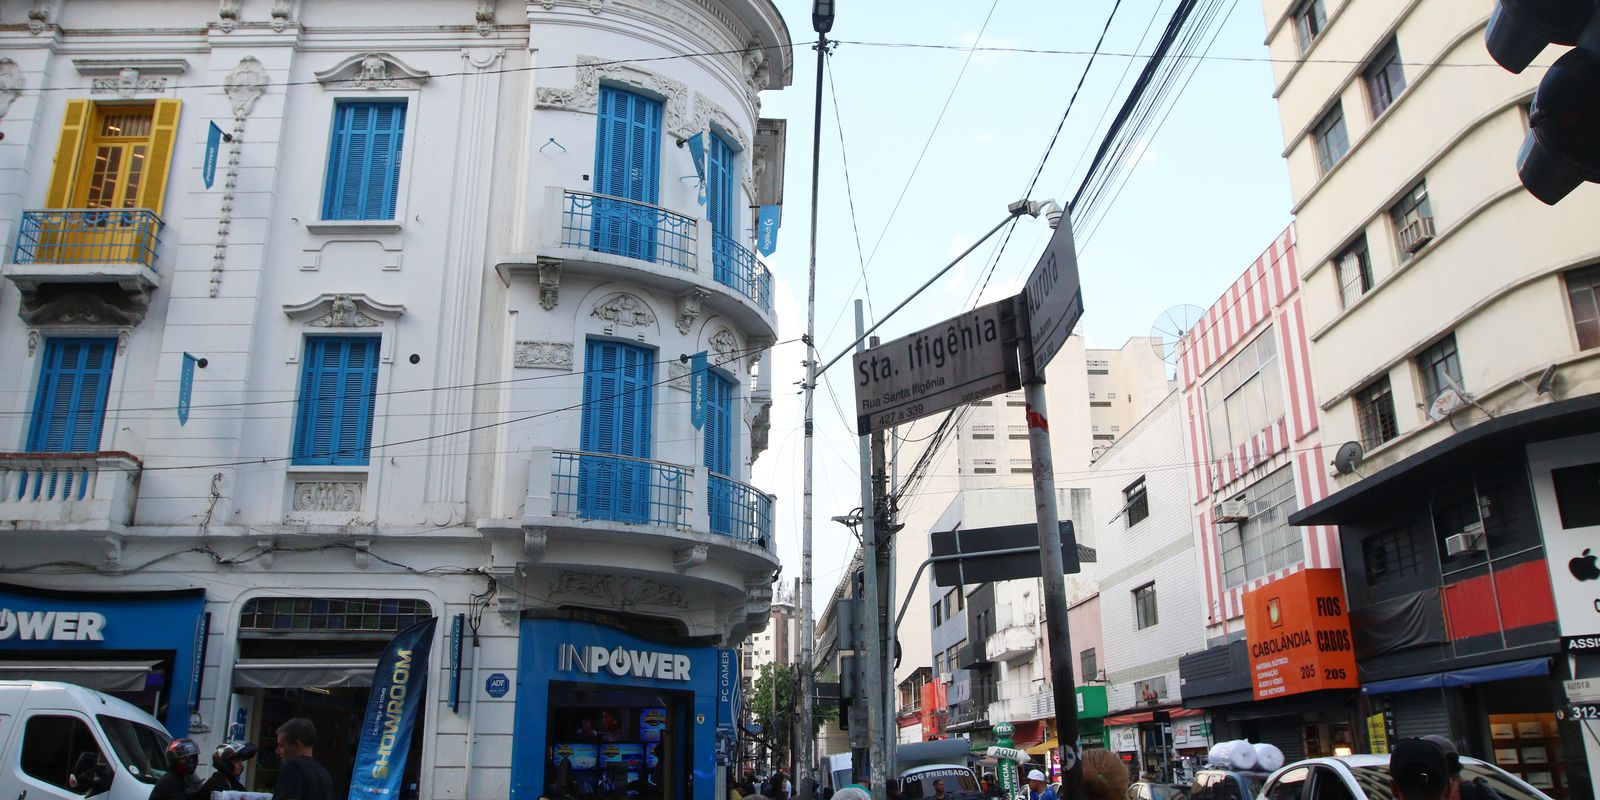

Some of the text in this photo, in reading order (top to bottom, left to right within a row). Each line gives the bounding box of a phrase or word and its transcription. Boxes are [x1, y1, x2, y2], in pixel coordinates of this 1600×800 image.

[1028, 251, 1059, 321] Aurora
[859, 315, 997, 387] Sta. Ifigênia
[862, 376, 945, 411] Rua Santa Ifigênia
[879, 404, 925, 425] 427 a 339
[1317, 597, 1341, 616] FIOS
[194, 619, 206, 682] NOTEBOOK
[1316, 630, 1350, 652] CABOS
[1568, 638, 1600, 650] ASSI
[452, 663, 459, 677] PC
[558, 643, 691, 681] INPOWER
[1301, 664, 1316, 680] 205
[1324, 669, 1346, 680] 205
[490, 679, 505, 688] ADT
[722, 690, 729, 702] PC
[372, 649, 413, 780] SHOWROOM
[996, 723, 1013, 733] mix
[994, 748, 1018, 758] AQUI
[906, 769, 970, 784] DOG PRENSADO
[1002, 763, 1011, 790] OFICIAL
